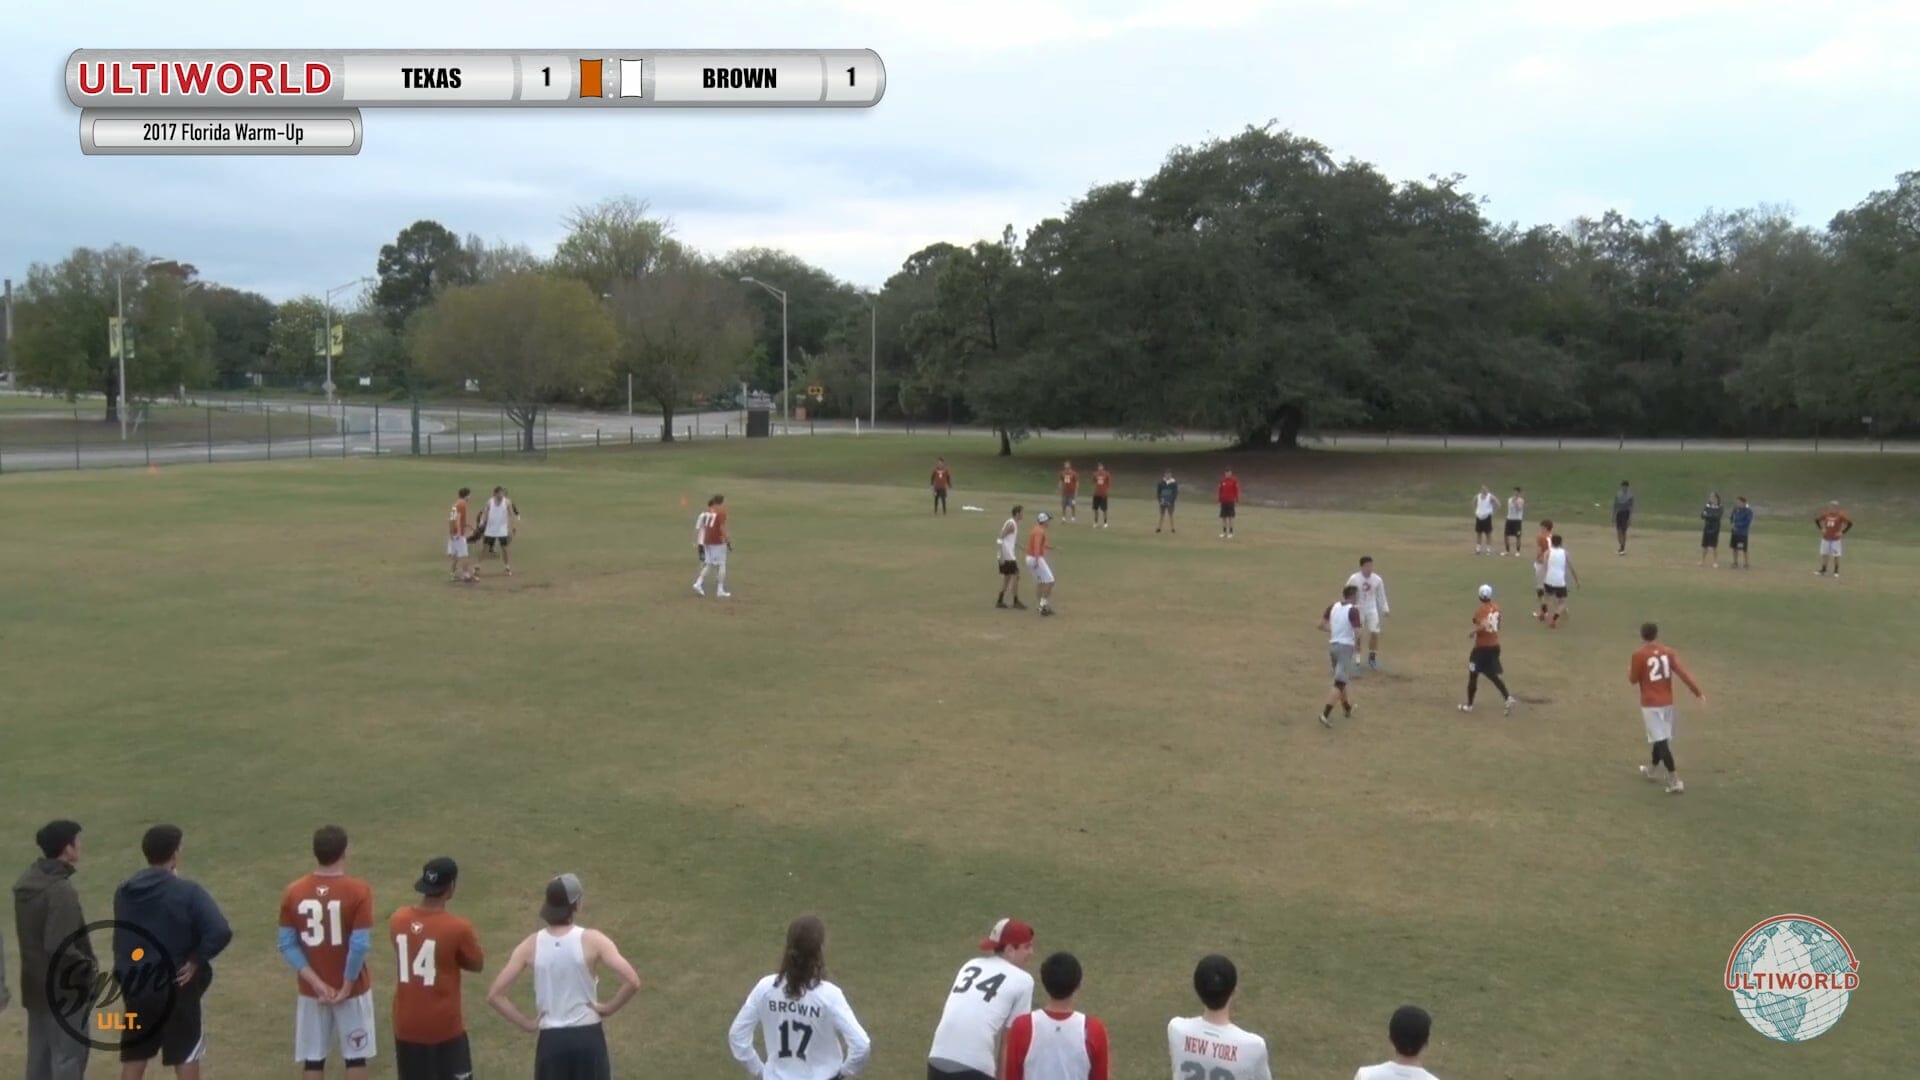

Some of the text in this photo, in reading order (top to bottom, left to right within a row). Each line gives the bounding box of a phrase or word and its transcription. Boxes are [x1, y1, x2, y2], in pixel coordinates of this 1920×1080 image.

[1647, 655, 1670, 681] 21
[298, 899, 342, 946] 31
[396, 933, 436, 986] 14
[953, 966, 1007, 1003] 34
[768, 1000, 820, 1018] BROWN
[778, 1019, 813, 1061] 17
[1184, 1035, 1238, 1061] NEW YORK
